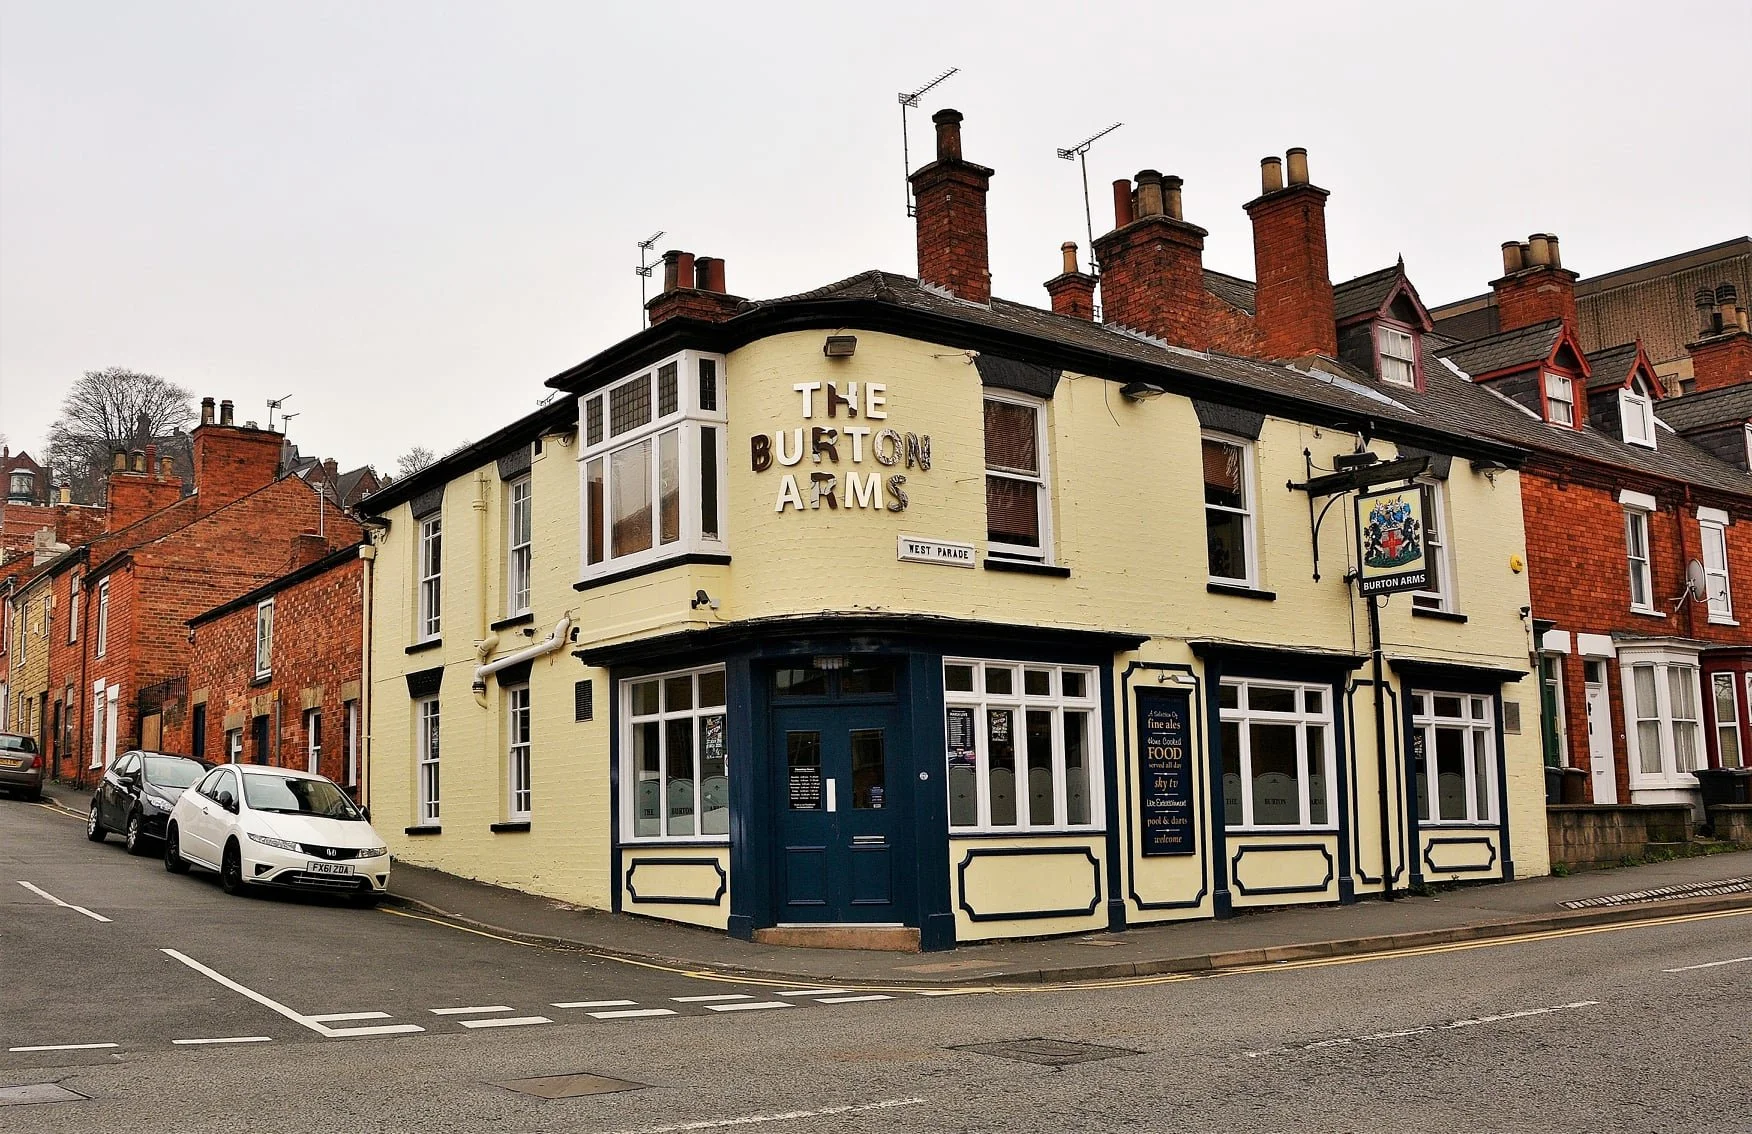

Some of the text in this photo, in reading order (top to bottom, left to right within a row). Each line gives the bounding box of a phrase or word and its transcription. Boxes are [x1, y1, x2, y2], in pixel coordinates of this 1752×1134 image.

[793, 381, 888, 419] THE
[751, 426, 931, 473] BURTON
[775, 471, 909, 513] ARMS
[909, 544, 968, 559] WEST PARADE
[1364, 574, 1426, 590] BURTON ARMS
[1148, 718, 1180, 729] fine ales
[1148, 746, 1182, 760] FOOD
[1154, 776, 1178, 792] sky tv
[1148, 816, 1188, 828] pool & darts
[1154, 834, 1182, 844] welcome
[312, 864, 332, 872] FX61
